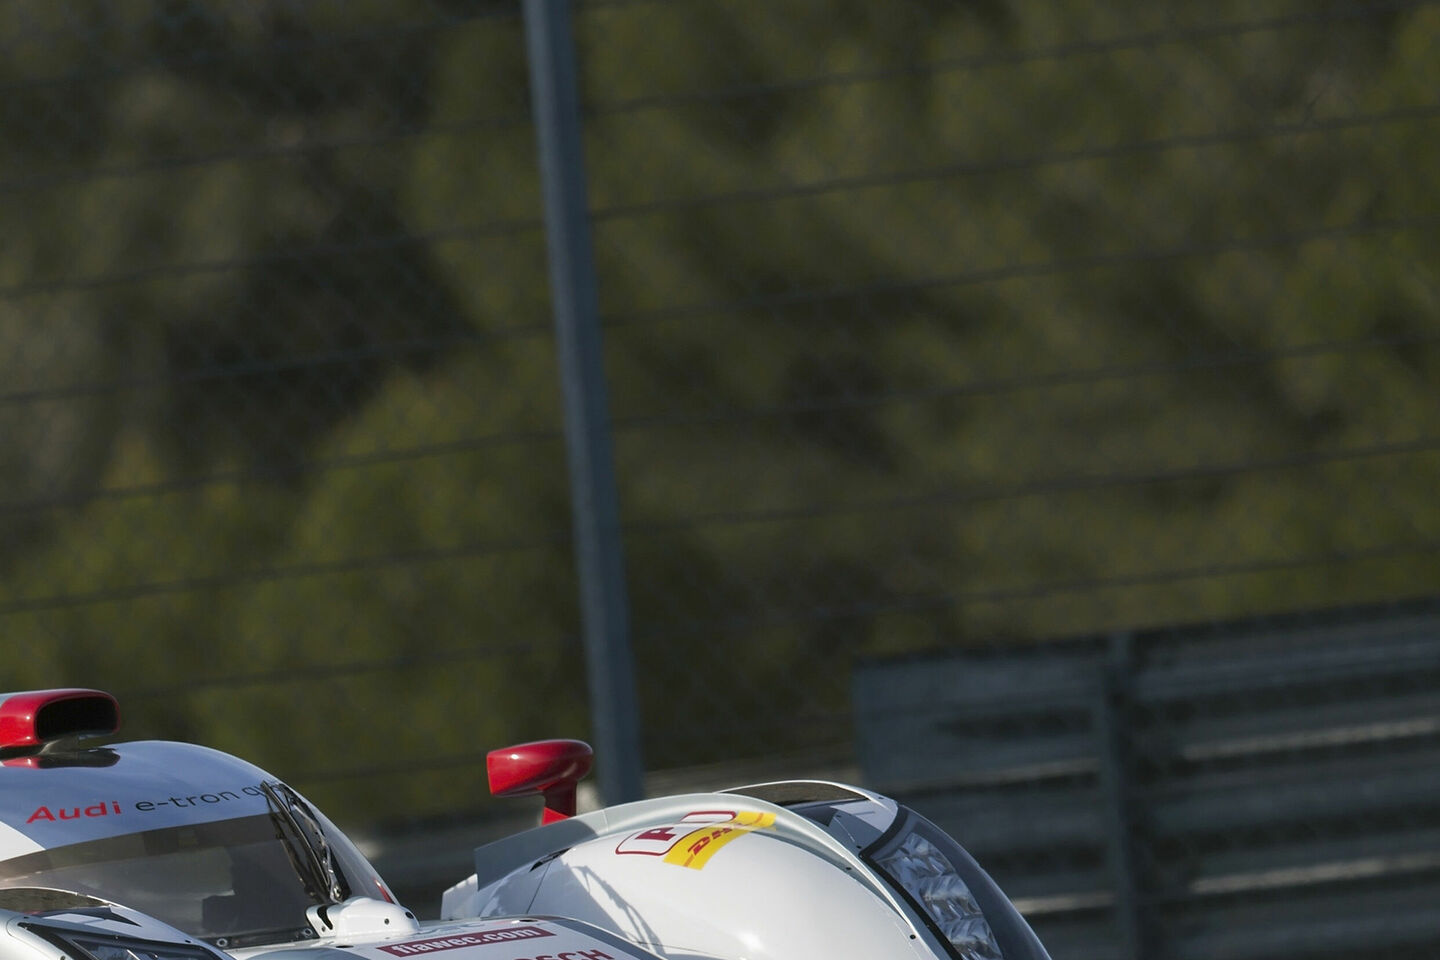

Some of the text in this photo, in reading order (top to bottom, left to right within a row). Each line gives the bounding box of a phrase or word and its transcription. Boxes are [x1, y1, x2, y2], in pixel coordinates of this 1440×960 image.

[26, 800, 121, 824] Audi
[135, 790, 241, 812] e-tron
[391, 927, 541, 955] fiawec.com
